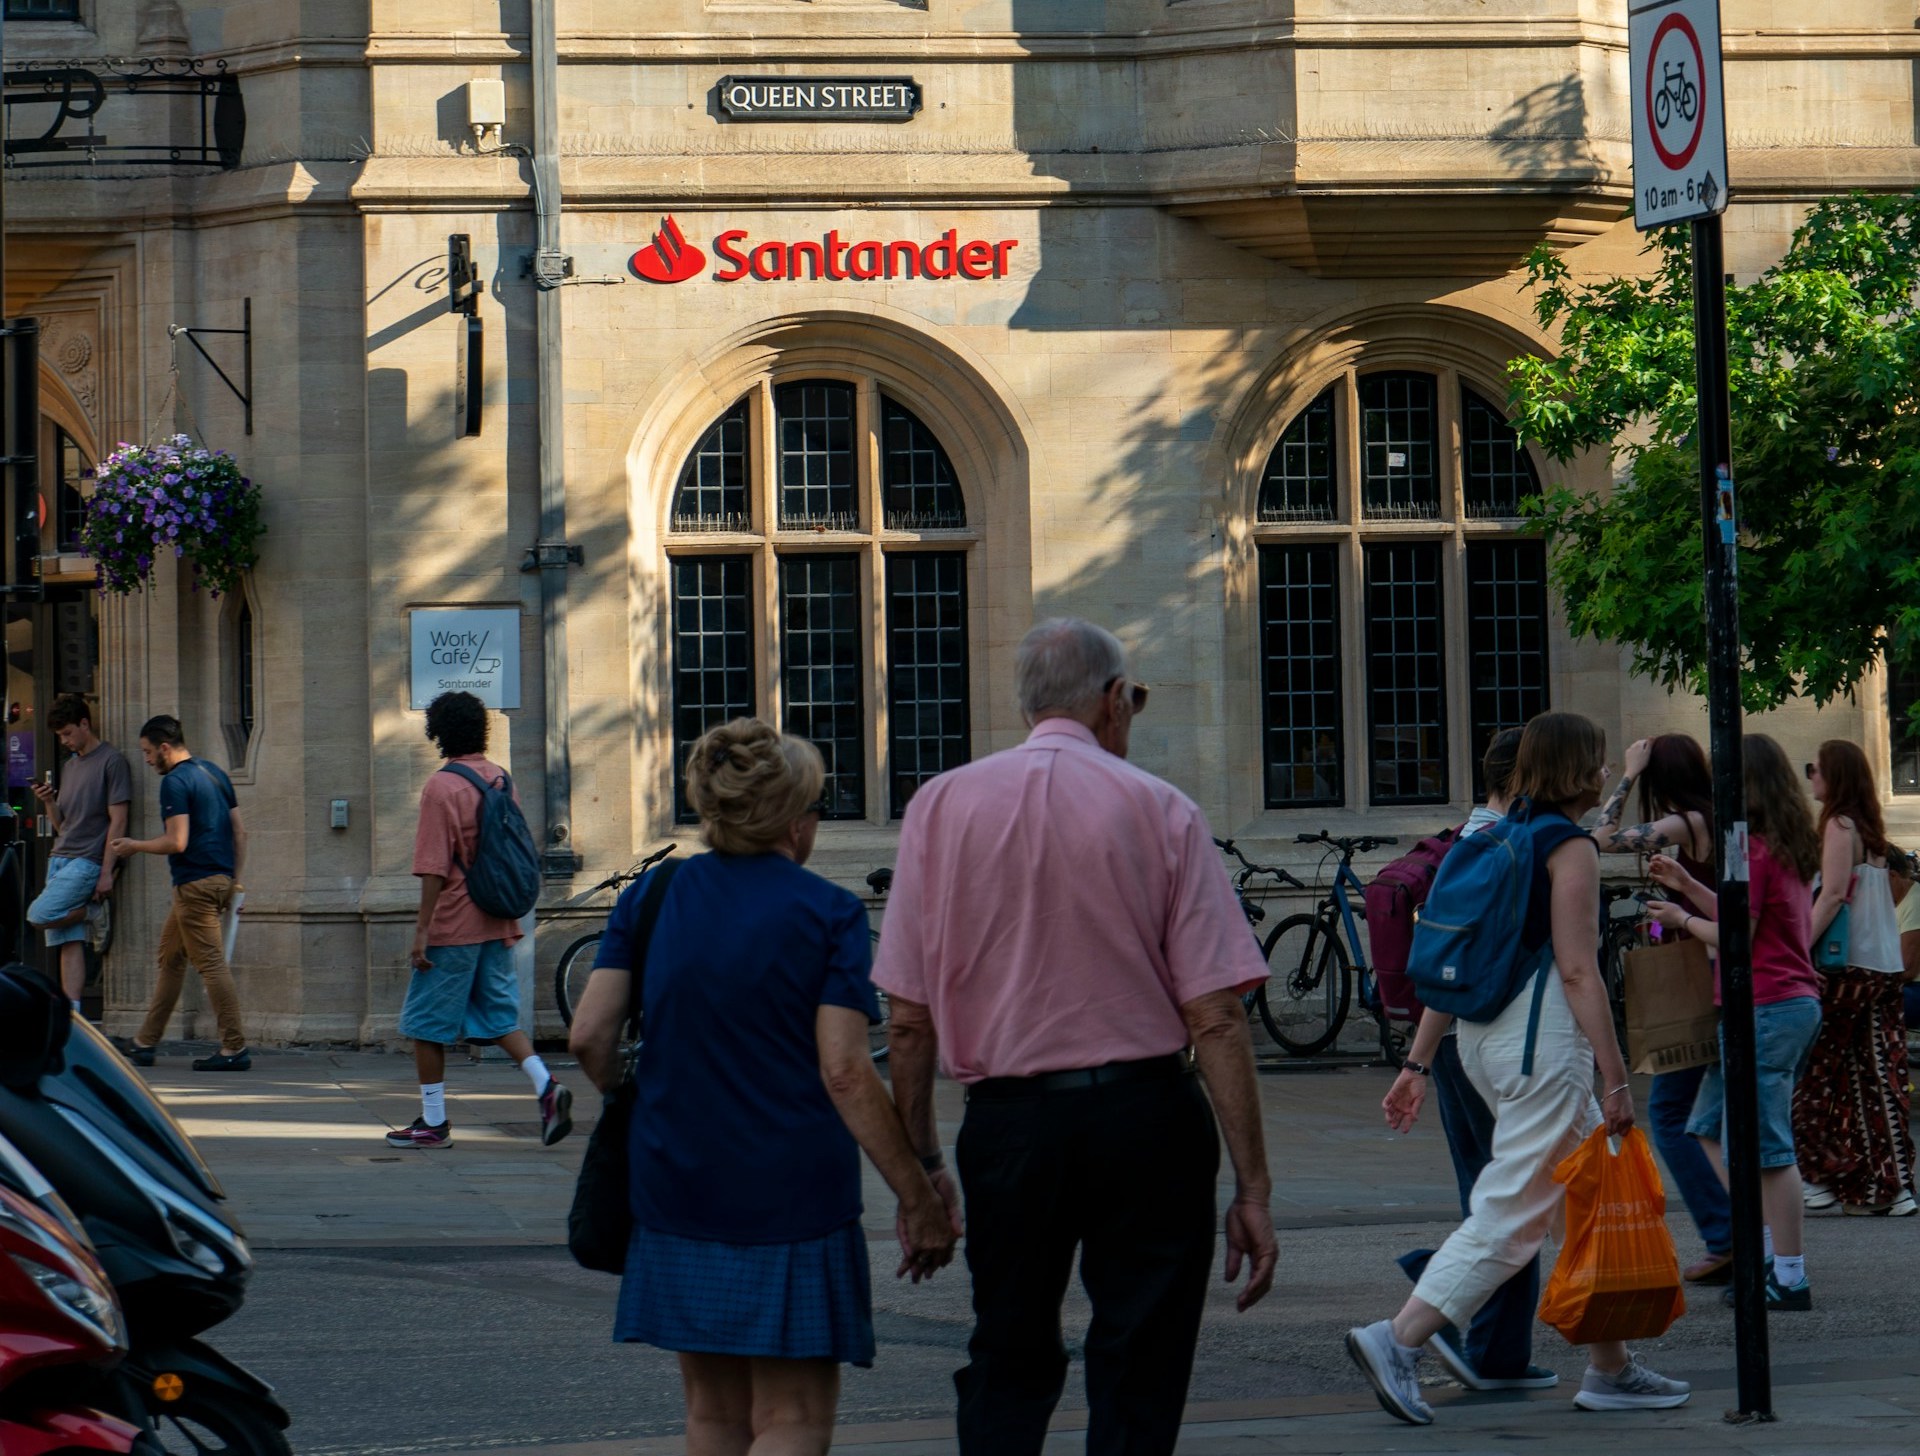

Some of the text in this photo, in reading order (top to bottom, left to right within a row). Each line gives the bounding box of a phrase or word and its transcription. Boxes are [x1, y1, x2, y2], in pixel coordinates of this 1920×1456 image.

[730, 85, 911, 111] QUEEN STREET
[716, 229, 1018, 281] Santander
[430, 630, 478, 647] Work
[430, 648, 471, 665] Café
[438, 679, 492, 689] Santander
